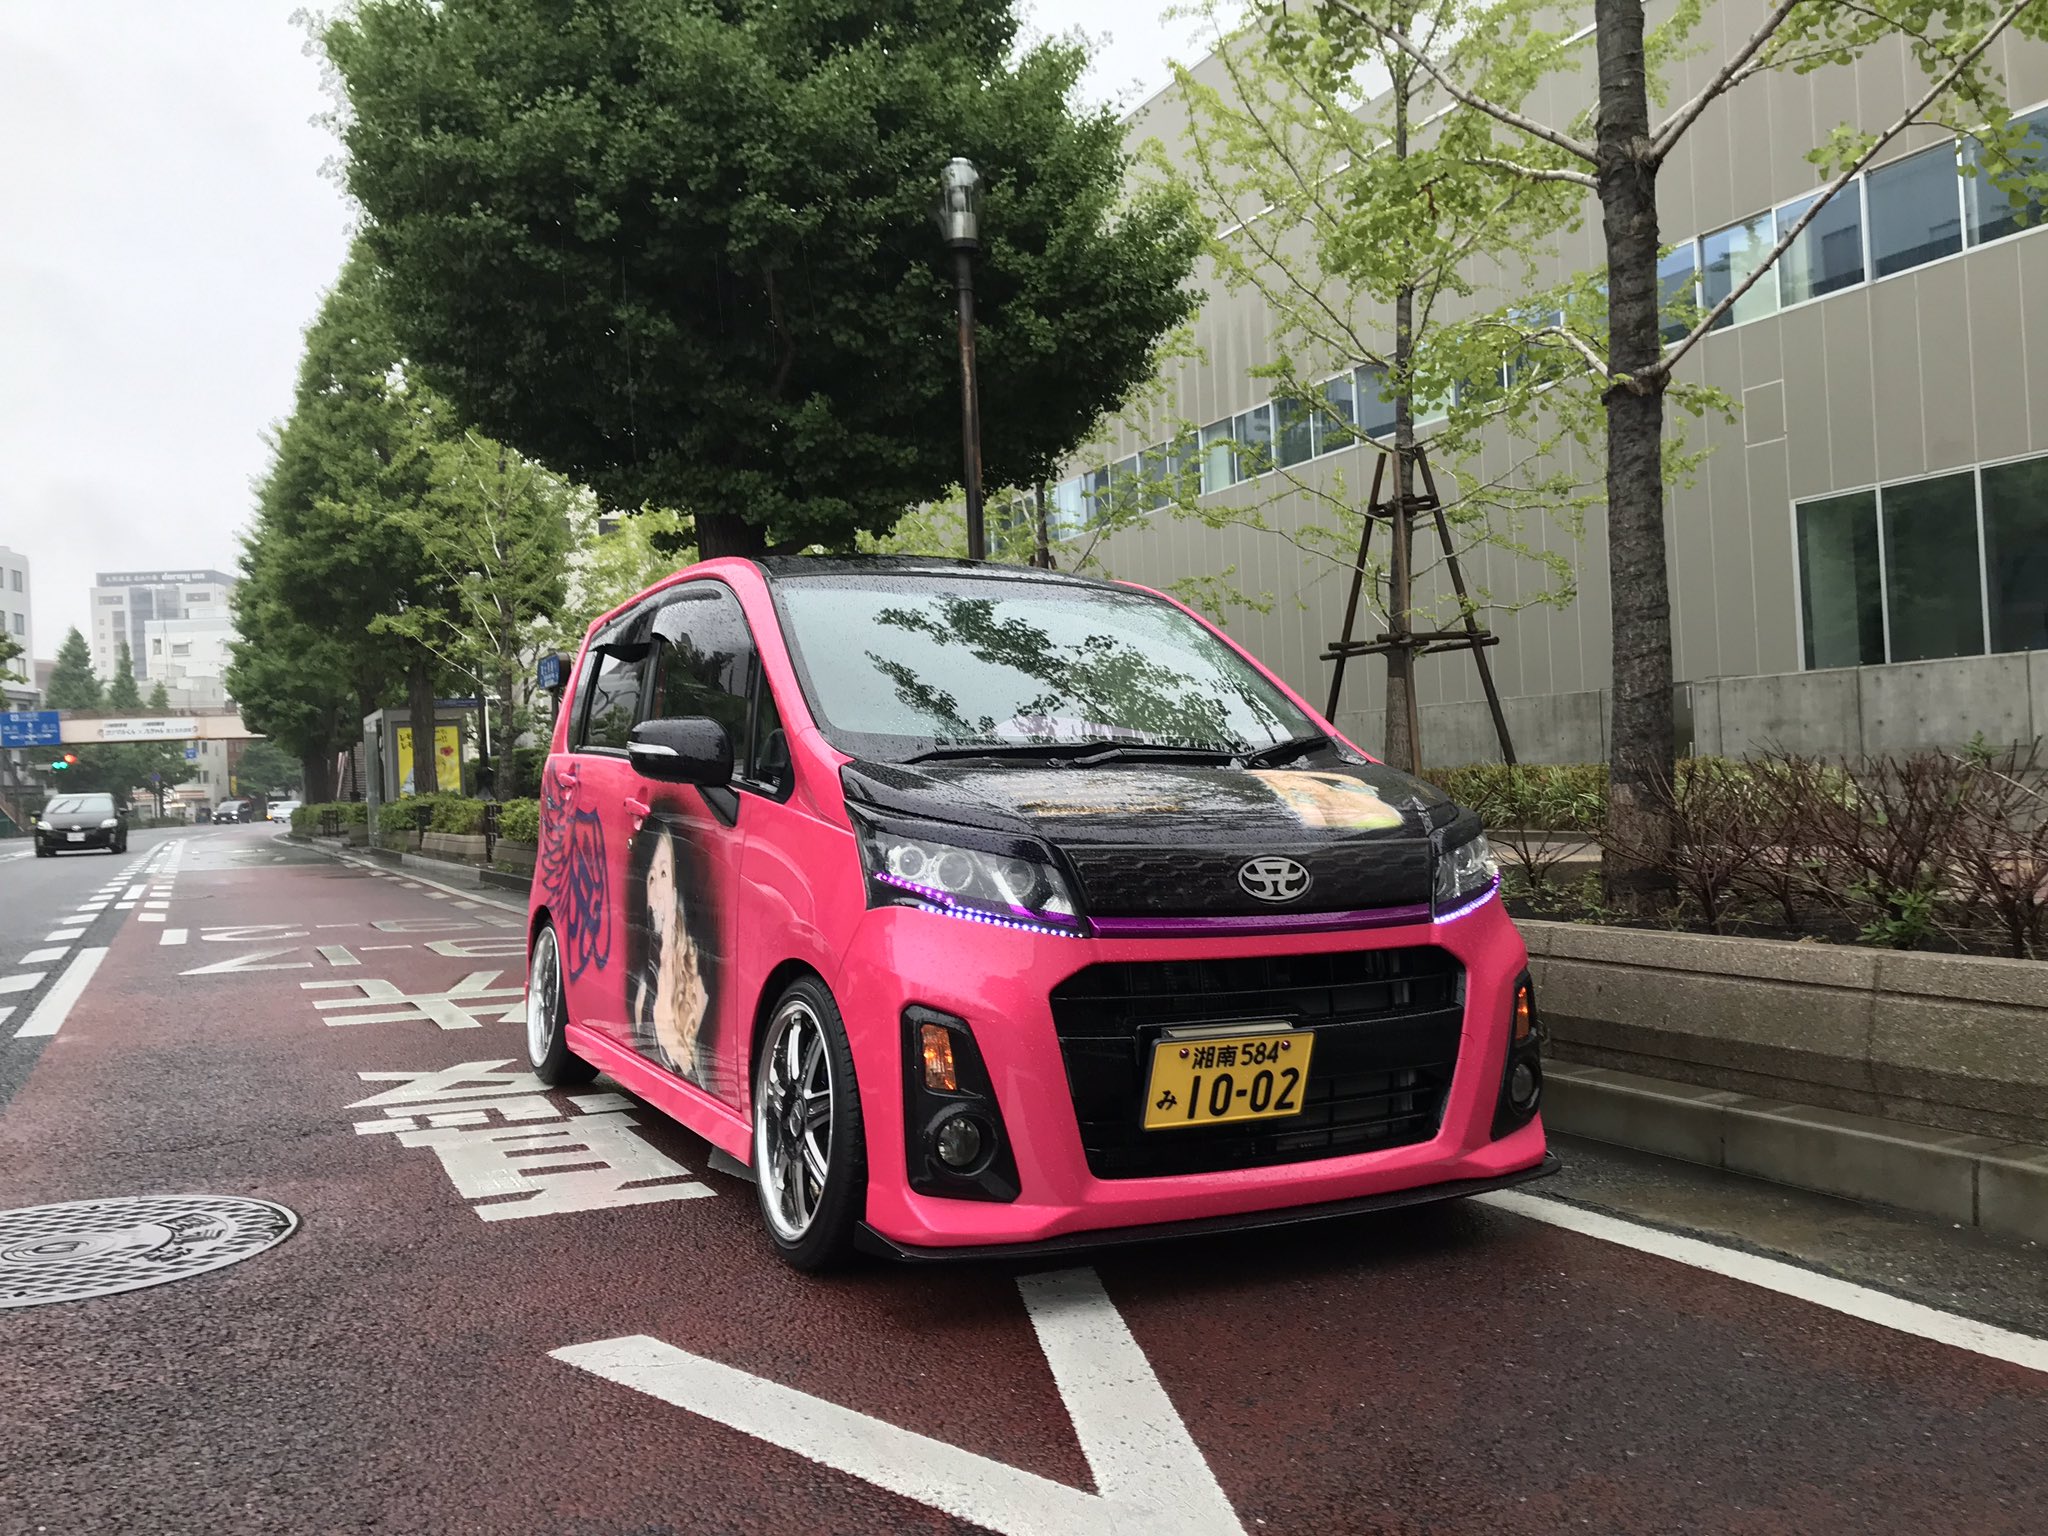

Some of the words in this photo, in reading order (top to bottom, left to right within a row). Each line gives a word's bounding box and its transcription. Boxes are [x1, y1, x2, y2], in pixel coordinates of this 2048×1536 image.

[1192, 1045, 1239, 1070] 湘南
[1241, 1040, 1280, 1066] 584
[1156, 1090, 1178, 1110] み
[1187, 1067, 1300, 1120] 10-02
